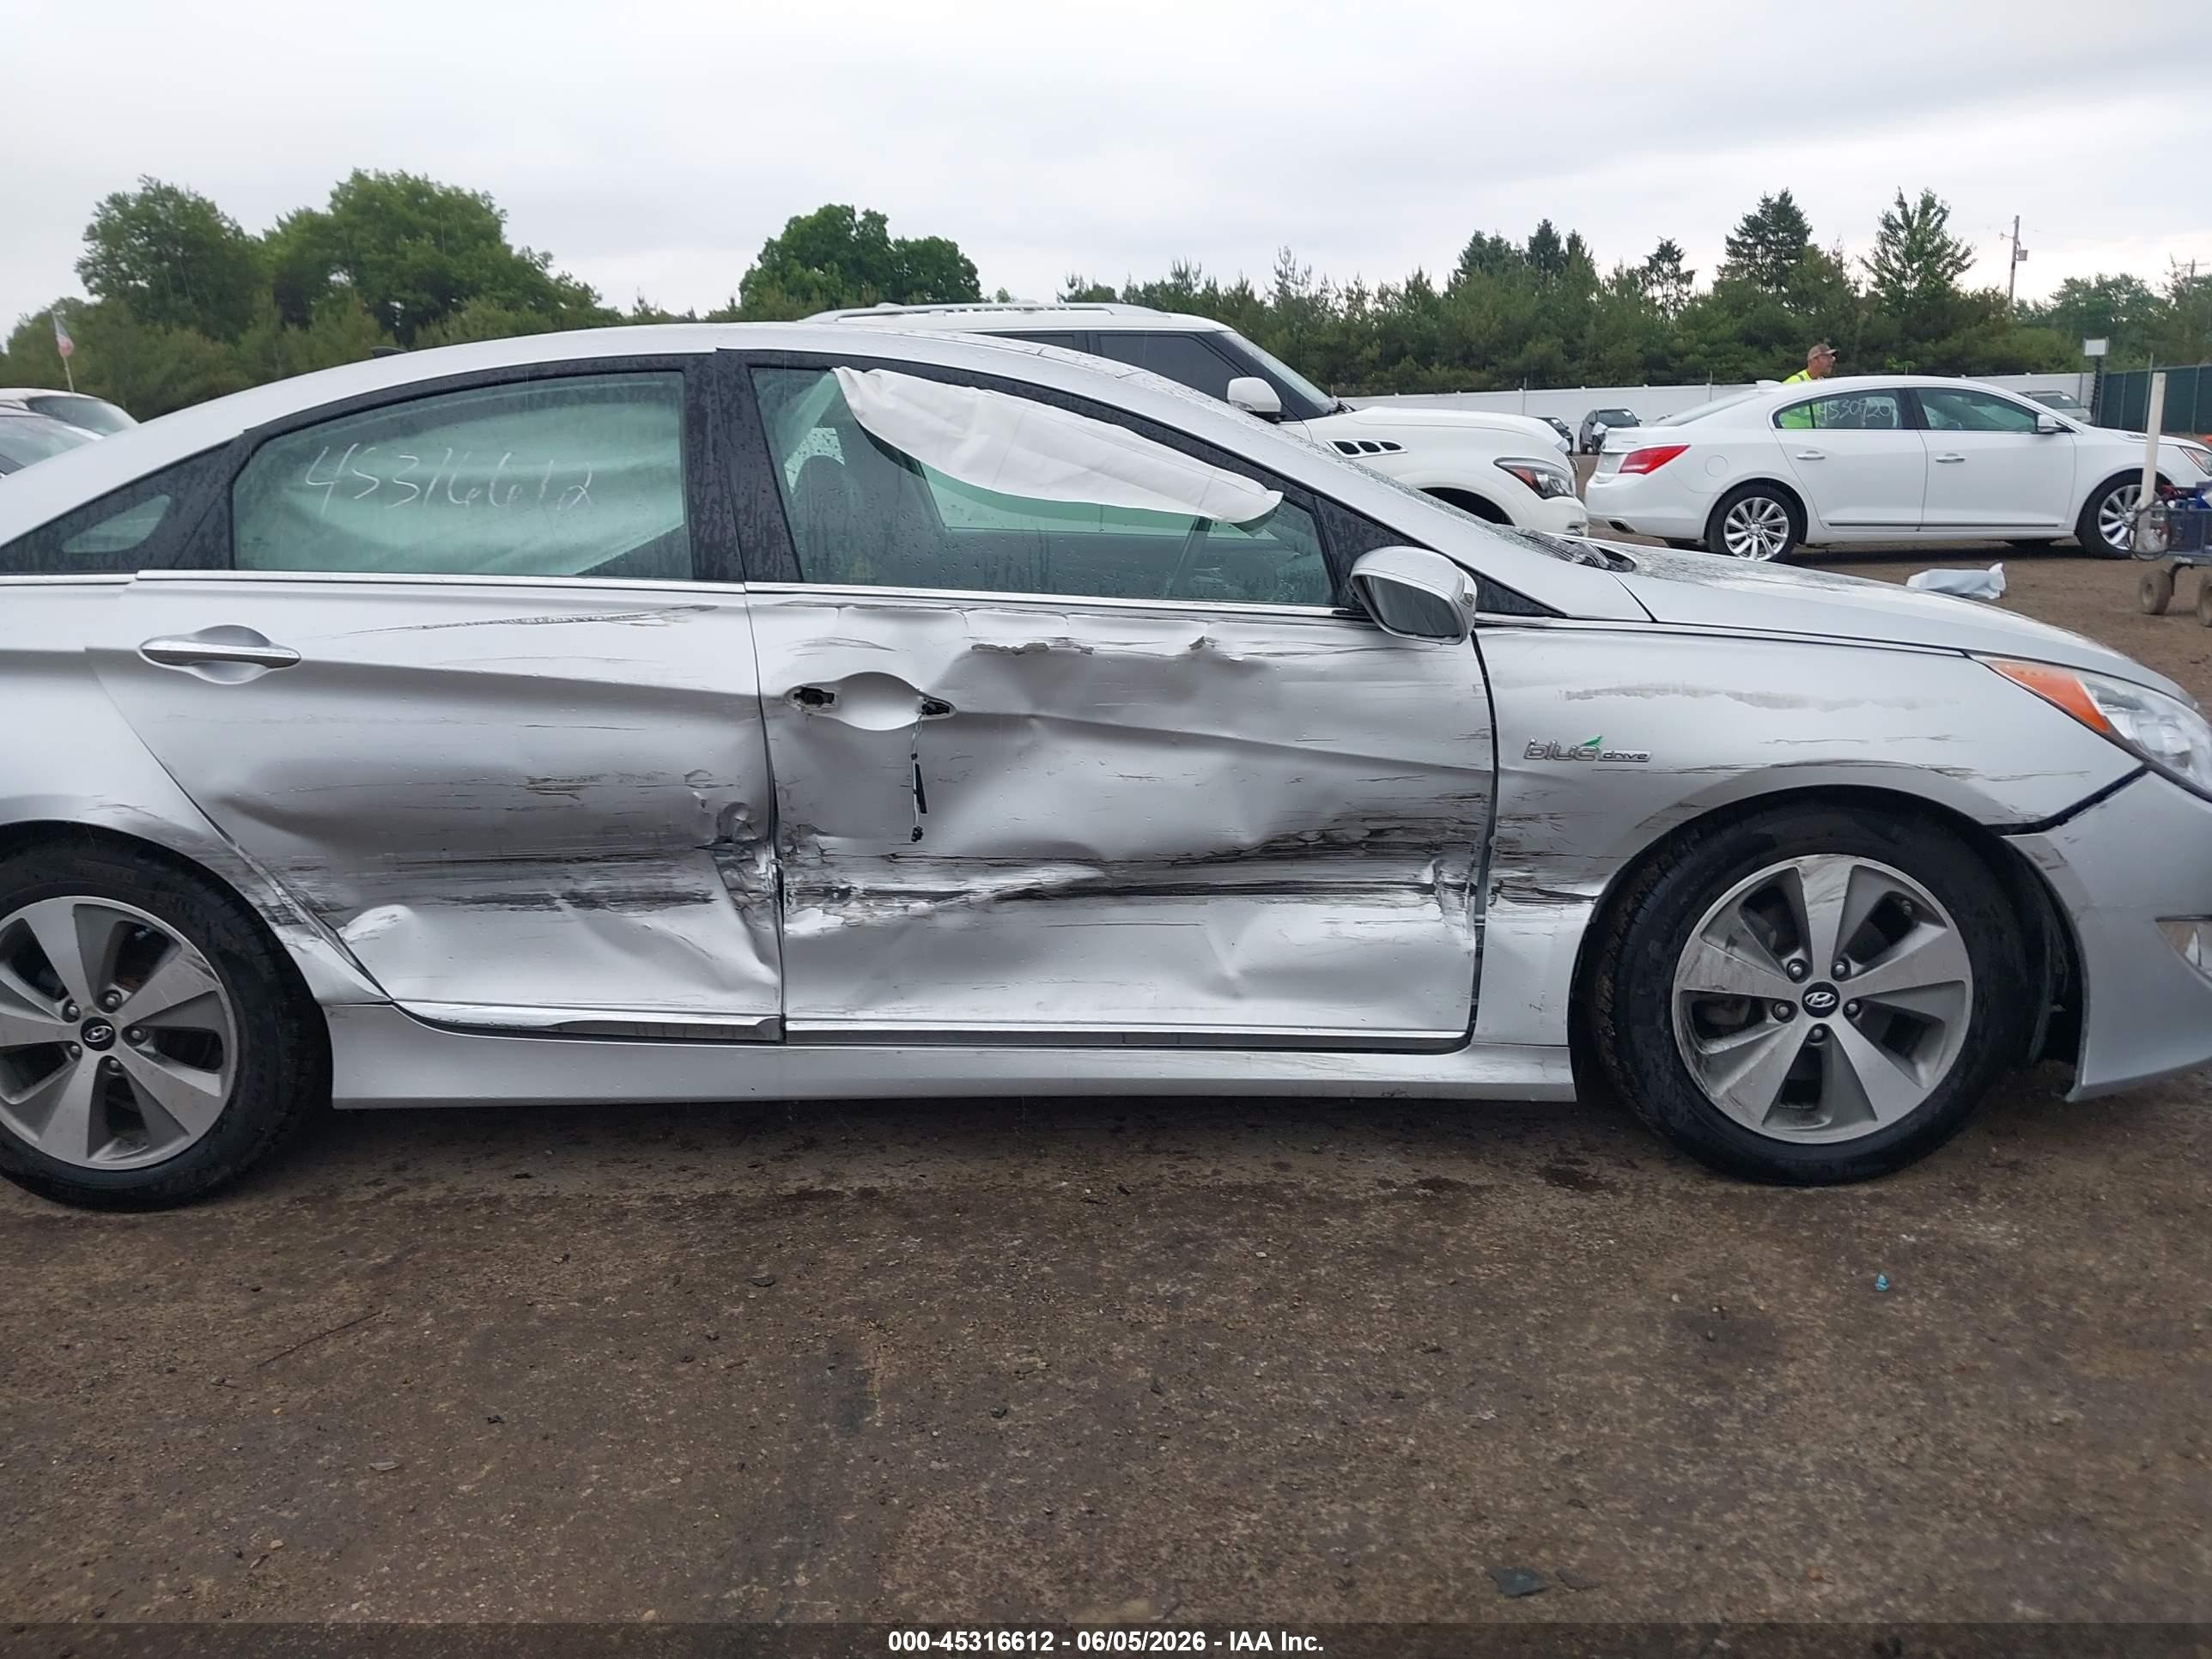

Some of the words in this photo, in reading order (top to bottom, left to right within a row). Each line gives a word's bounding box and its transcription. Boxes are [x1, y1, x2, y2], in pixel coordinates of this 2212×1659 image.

[304, 442, 593, 515] 45316612
[1523, 737, 1600, 761] blue
[1601, 750, 1650, 761] drive
